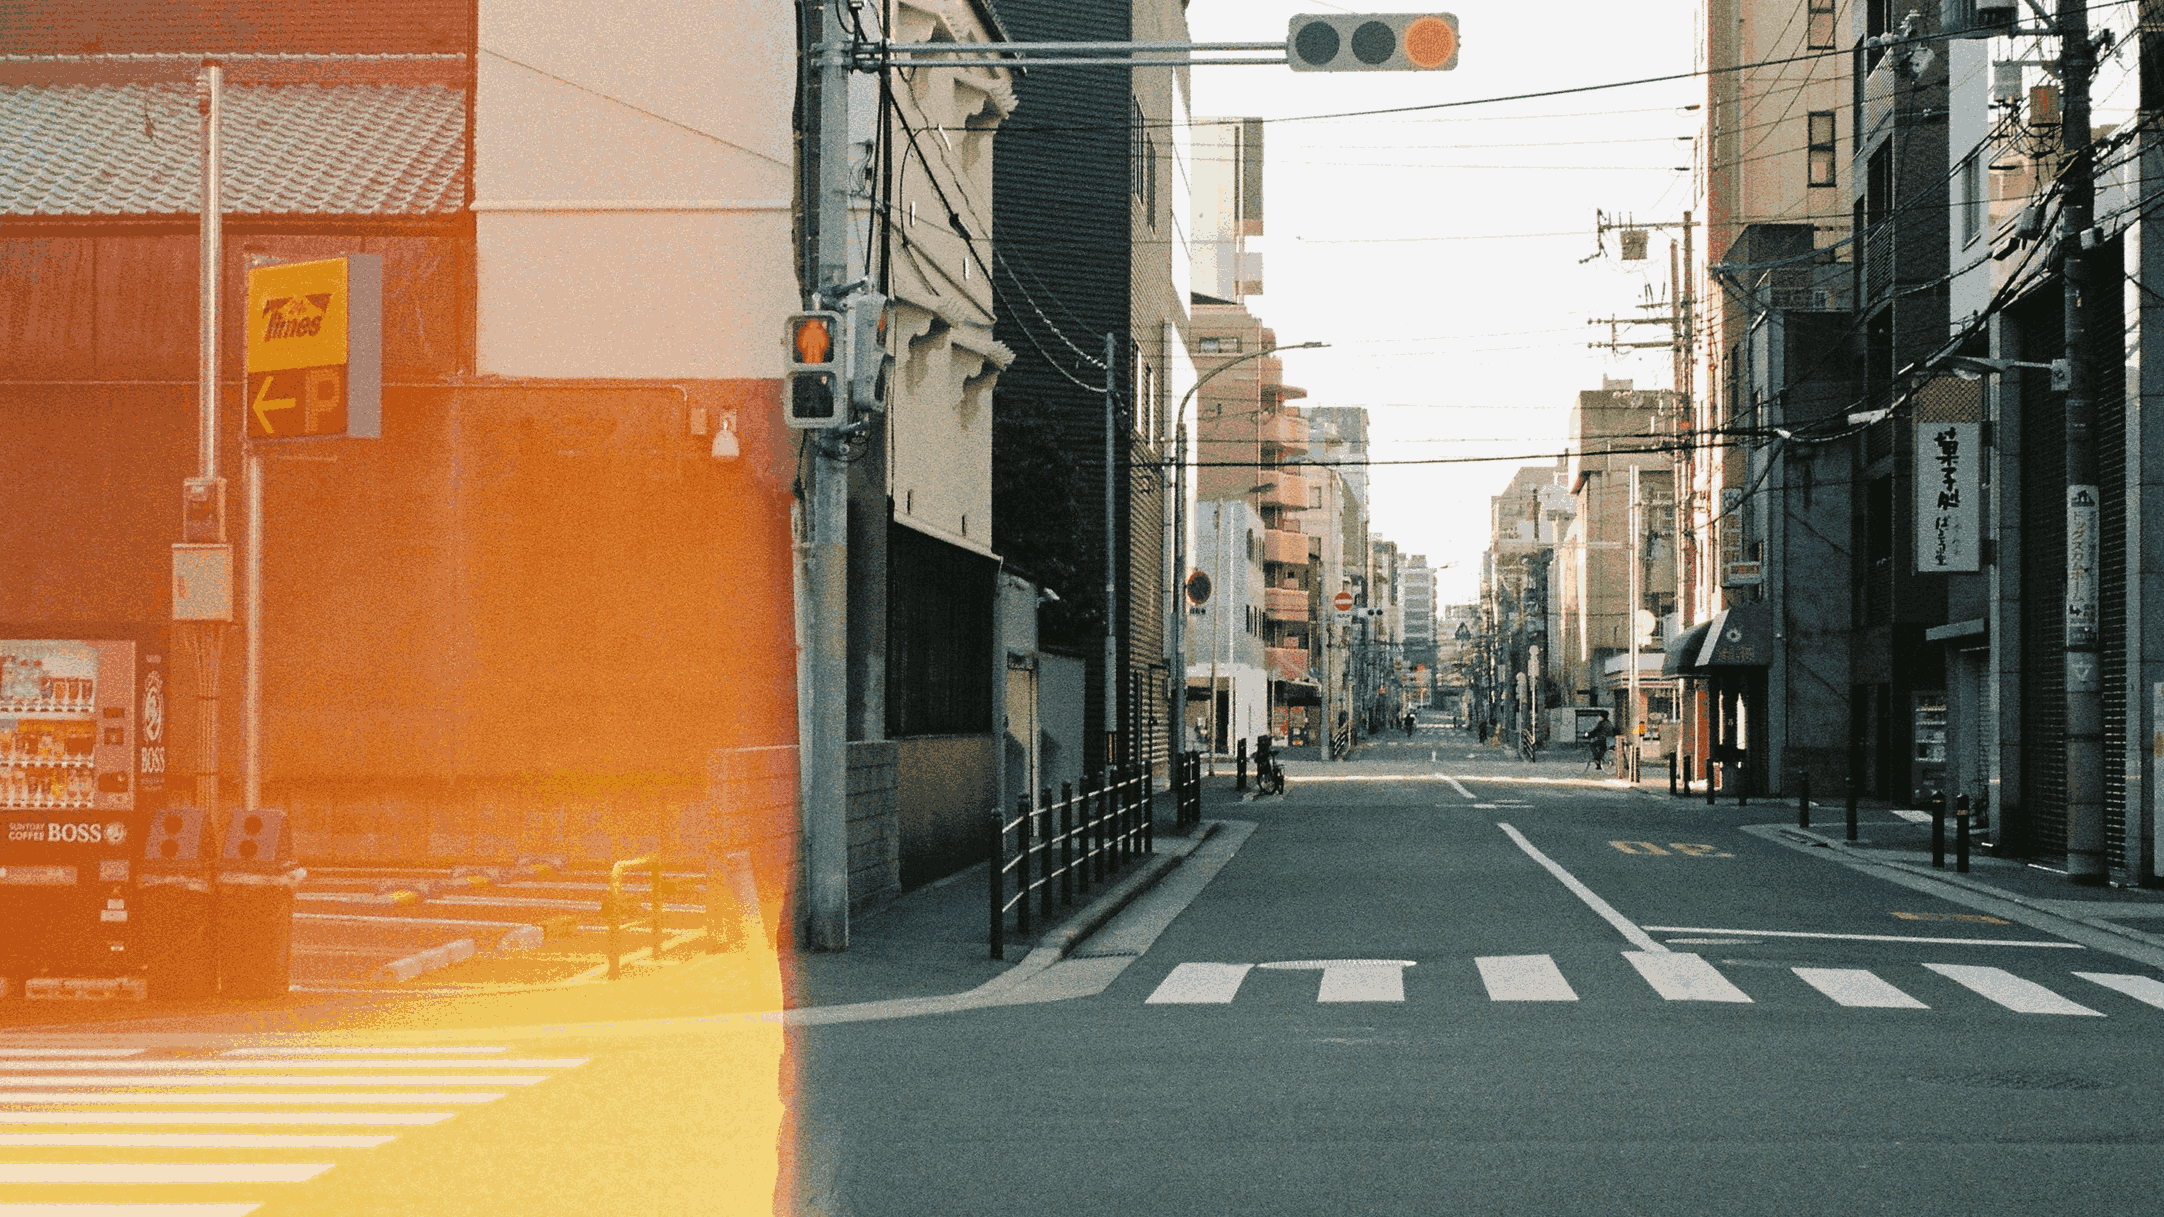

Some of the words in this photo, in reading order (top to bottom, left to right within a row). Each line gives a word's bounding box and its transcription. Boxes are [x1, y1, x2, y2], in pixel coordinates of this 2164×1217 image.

[262, 292, 333, 342] Times
[304, 368, 341, 433] P
[1934, 426, 1960, 511] 菓子処
[141, 746, 165, 773] BOSS
[8, 822, 45, 831] SUNTORY
[8, 831, 45, 842] COFFEE
[48, 822, 101, 843] BOSS
